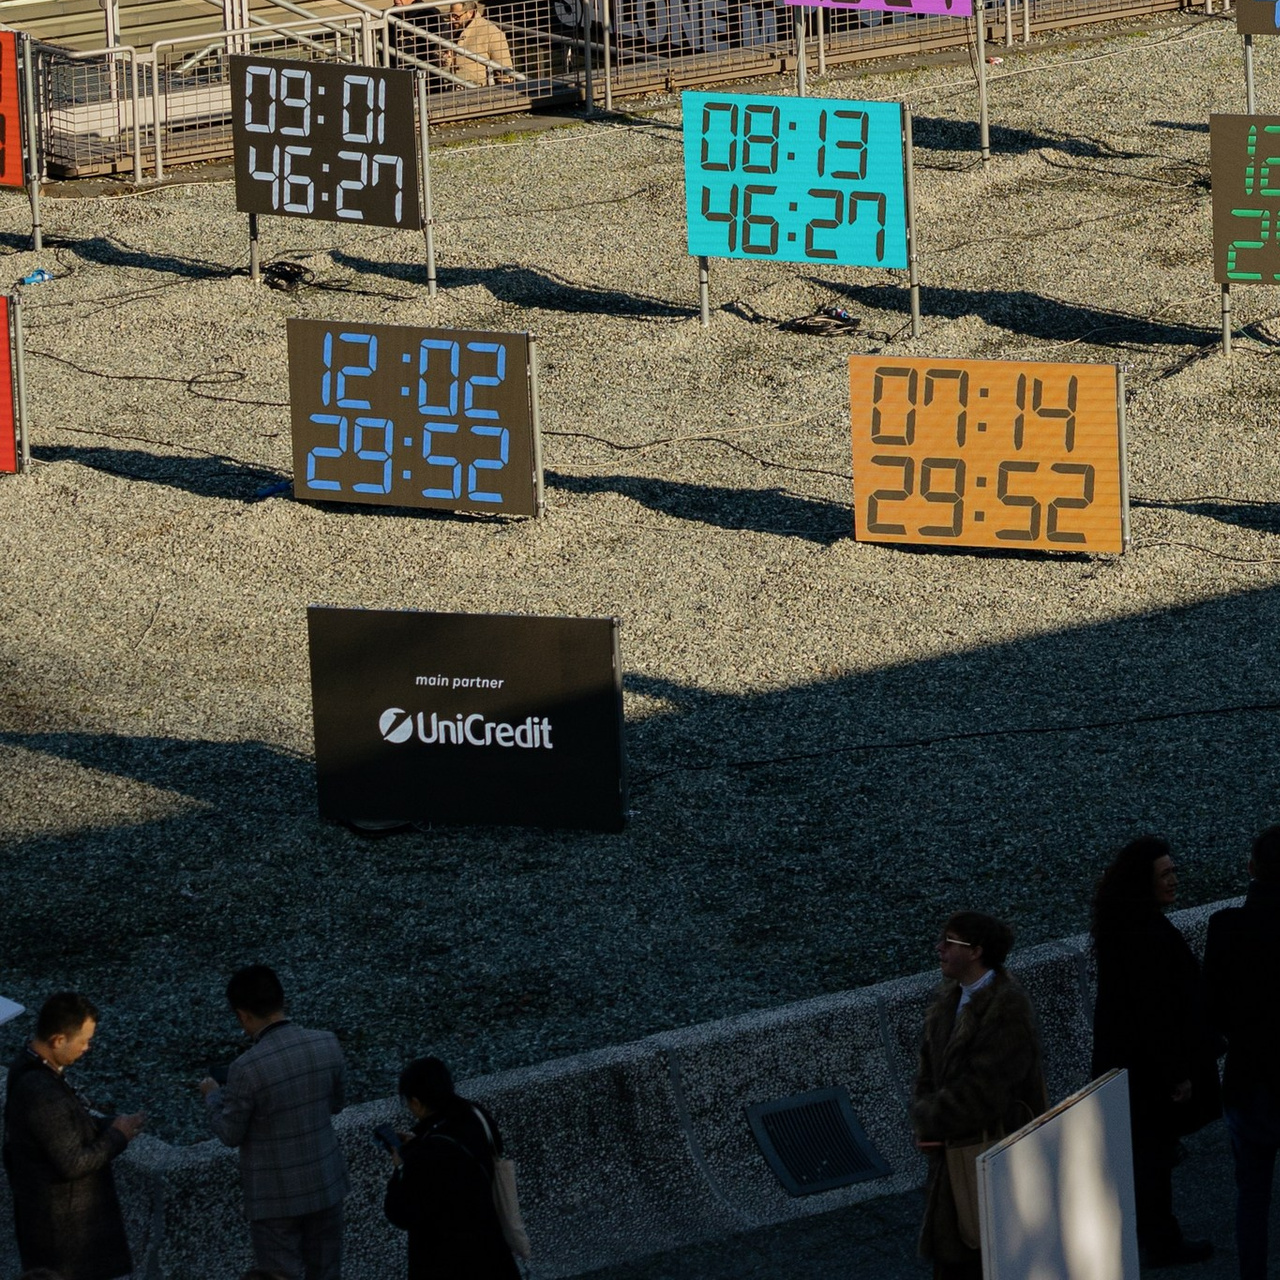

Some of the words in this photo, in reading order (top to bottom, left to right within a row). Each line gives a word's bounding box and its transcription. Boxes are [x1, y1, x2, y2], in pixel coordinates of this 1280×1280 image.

[244, 65, 386, 145] 09:01
[700, 101, 870, 181] 08:13
[247, 143, 404, 224] 46:27
[701, 183, 887, 263] 46:27
[321, 331, 507, 421] 12:02
[870, 366, 1079, 454] 07:14
[305, 413, 510, 504] 29:52
[866, 454, 1096, 544] 29:52
[415, 674, 449, 687] main
[452, 676, 505, 689] partner
[416, 711, 554, 749] UniCredit
